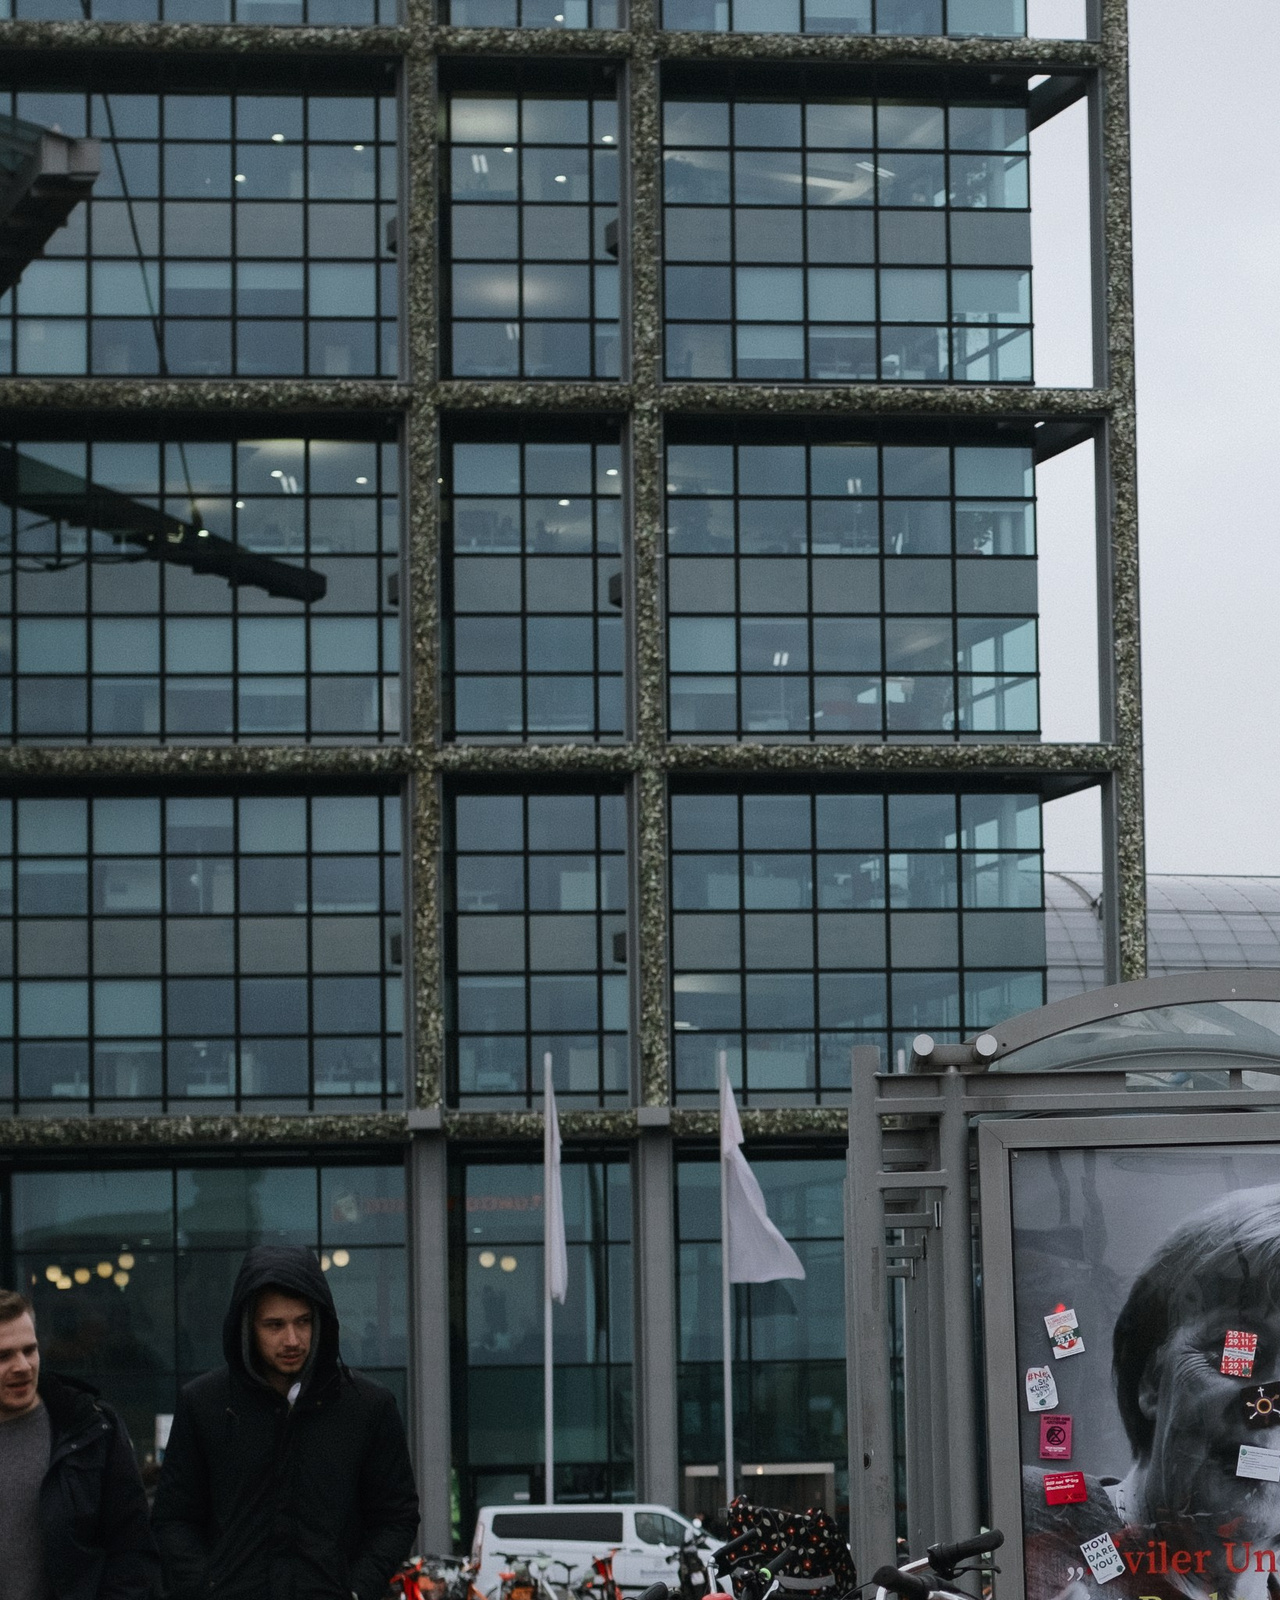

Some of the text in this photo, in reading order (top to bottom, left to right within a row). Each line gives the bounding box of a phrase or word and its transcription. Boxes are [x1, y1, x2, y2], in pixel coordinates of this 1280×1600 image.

[1083, 1534, 1109, 1554] HOW
[1087, 1544, 1115, 1564] DARE
[1093, 1553, 1119, 1572] YOU?
